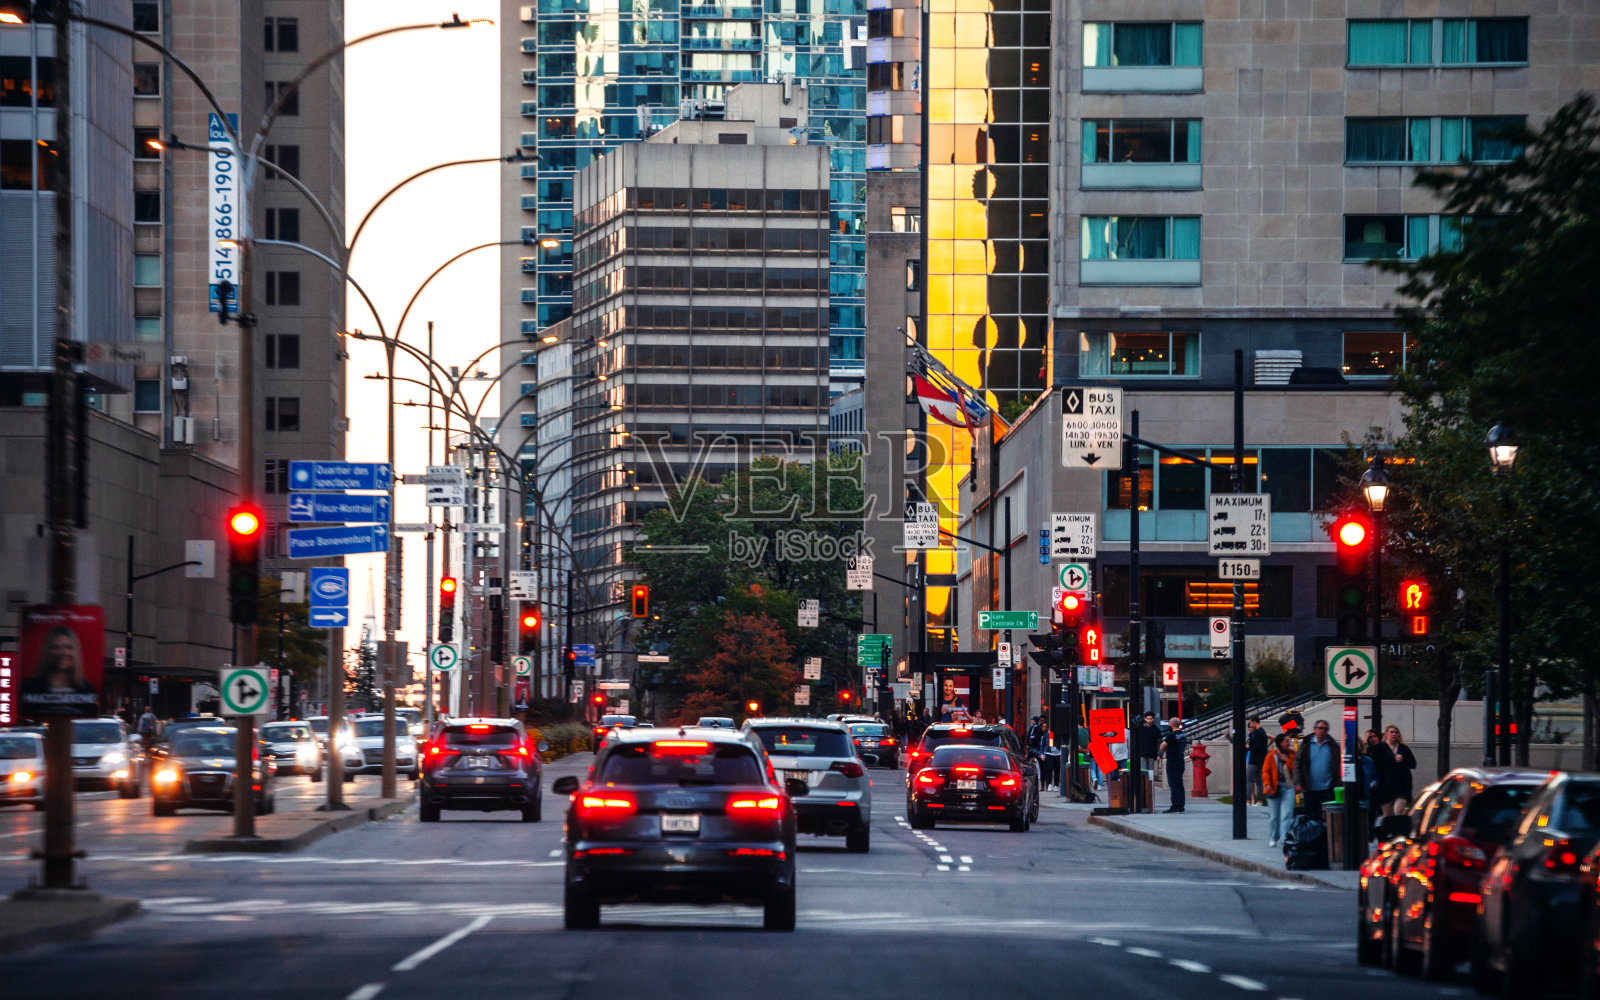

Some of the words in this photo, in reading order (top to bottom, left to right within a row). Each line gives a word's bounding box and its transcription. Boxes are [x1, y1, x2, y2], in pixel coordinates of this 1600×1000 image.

[1089, 393, 1114, 403] BUS
[1089, 405, 1115, 415] TAXI
[1215, 497, 1263, 507] MAXIMUM
[918, 505, 937, 513] BUS
[1056, 515, 1091, 523] MAXIMUM
[1091, 716, 1122, 725] DETOUR
